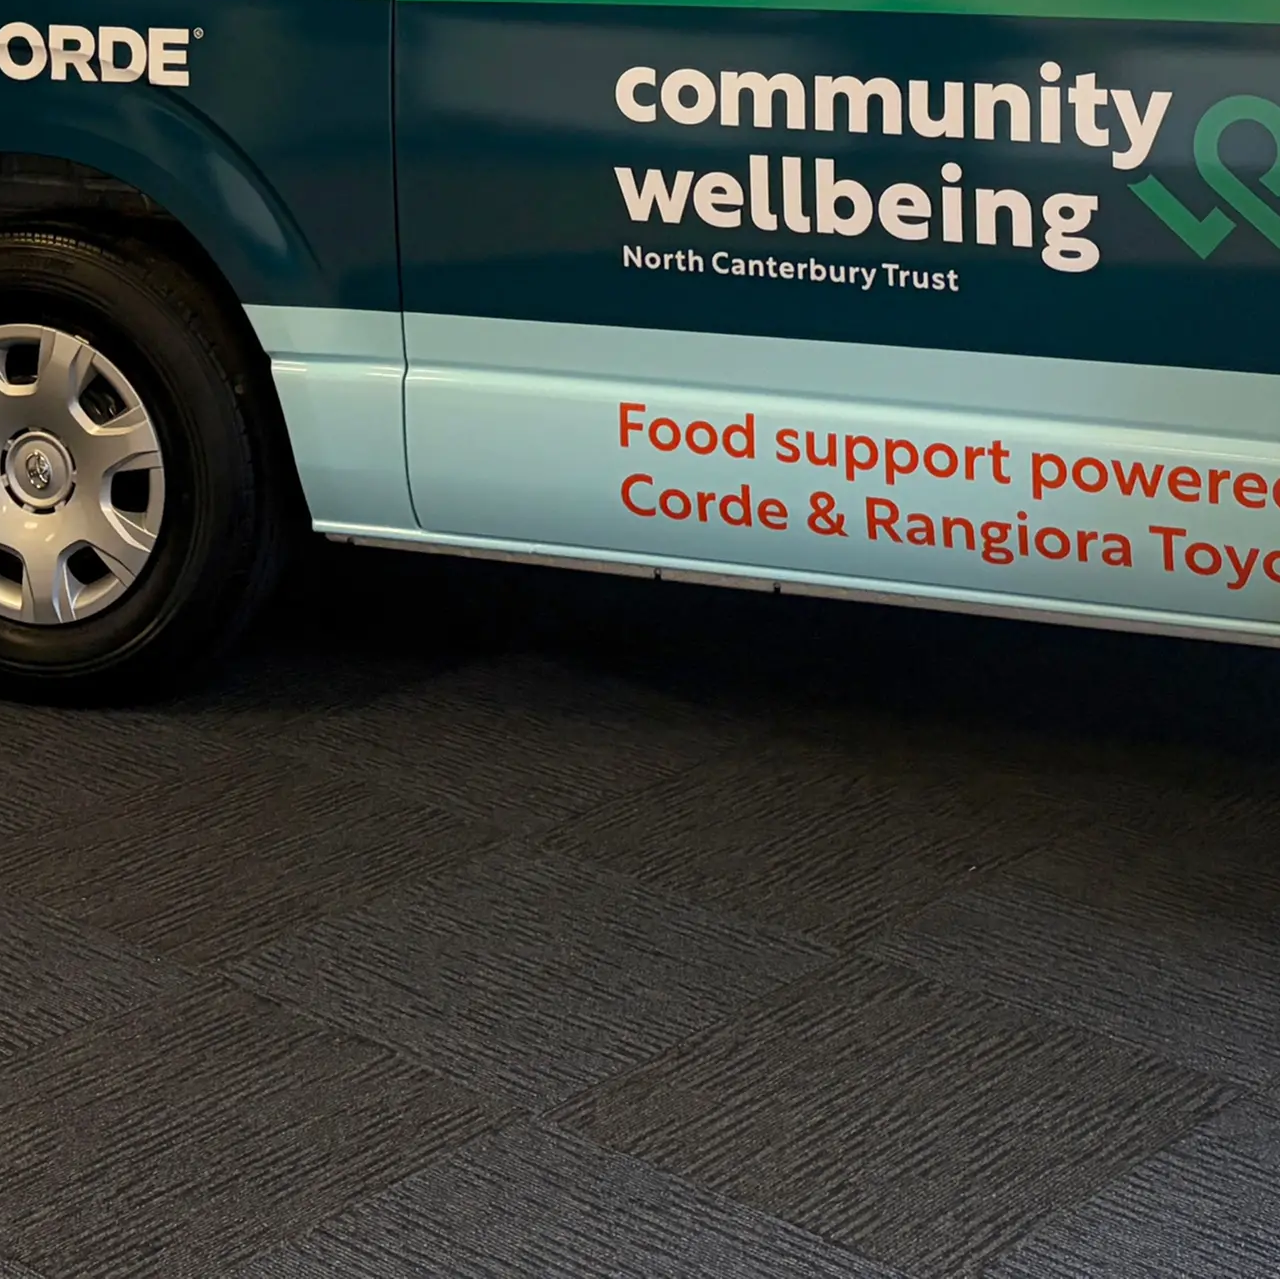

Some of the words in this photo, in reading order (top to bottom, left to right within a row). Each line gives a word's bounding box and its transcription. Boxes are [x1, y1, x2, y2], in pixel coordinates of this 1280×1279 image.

[615, 61, 1173, 170] community
[614, 154, 1100, 273] wellbeing
[623, 244, 704, 273] North
[711, 251, 877, 291] Canterbury
[881, 262, 959, 292] Trust
[619, 403, 755, 459] Food
[776, 426, 1011, 486] support
[621, 473, 788, 531] Corde
[807, 491, 847, 537] &
[866, 497, 1133, 567] Rangiora
